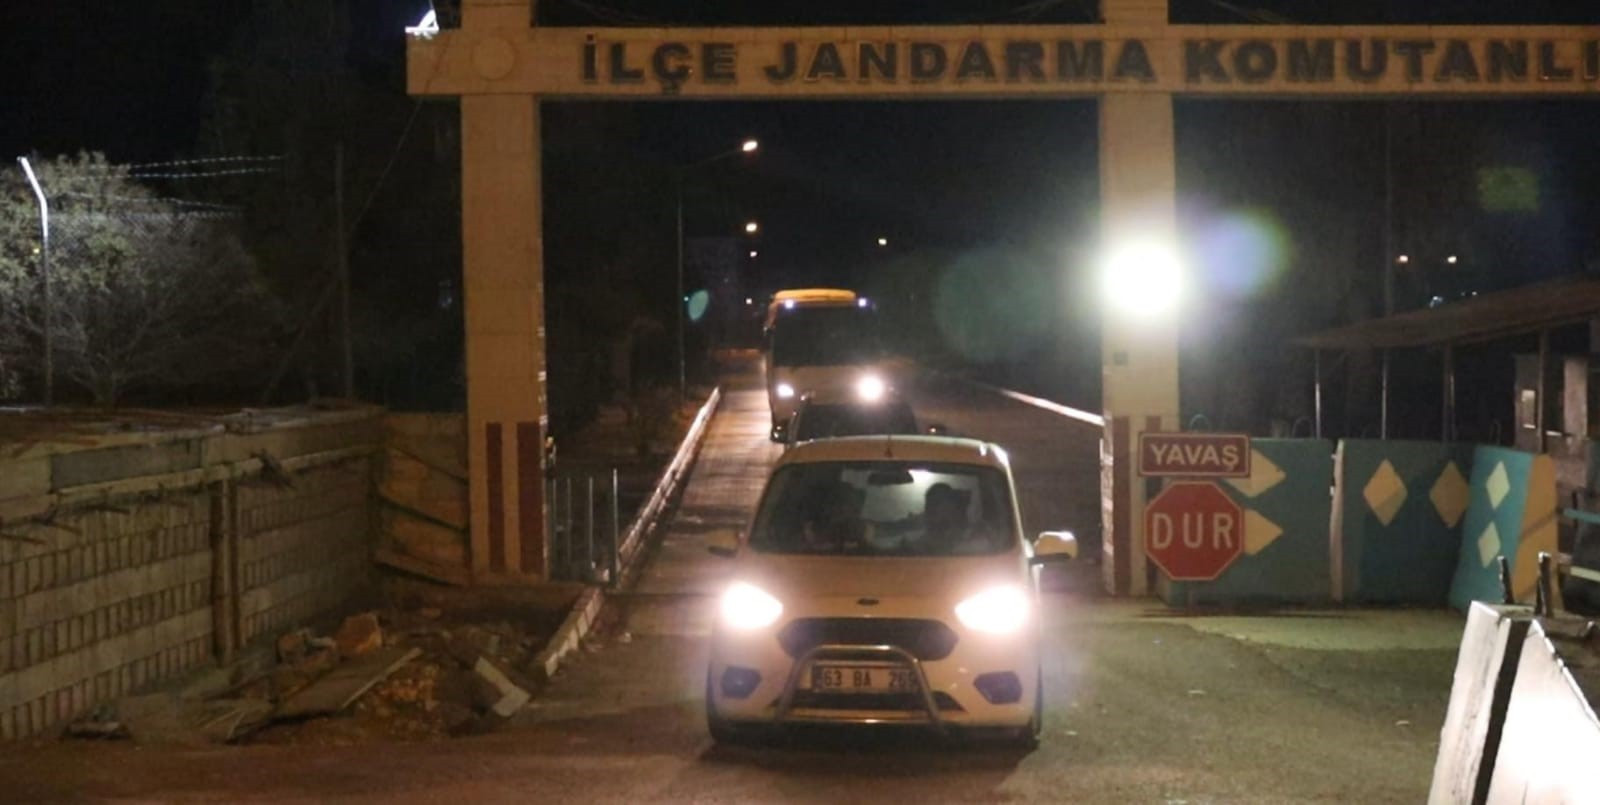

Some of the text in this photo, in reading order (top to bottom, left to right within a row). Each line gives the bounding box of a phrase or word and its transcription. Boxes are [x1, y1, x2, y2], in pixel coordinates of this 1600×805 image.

[581, 34, 737, 96] İLÇE
[763, 41, 1156, 85] JANDARMA
[1150, 443, 1240, 472] YAVAŞ
[1152, 512, 1233, 550] DUR
[823, 669, 842, 687] 63
[853, 670, 872, 687] BA
